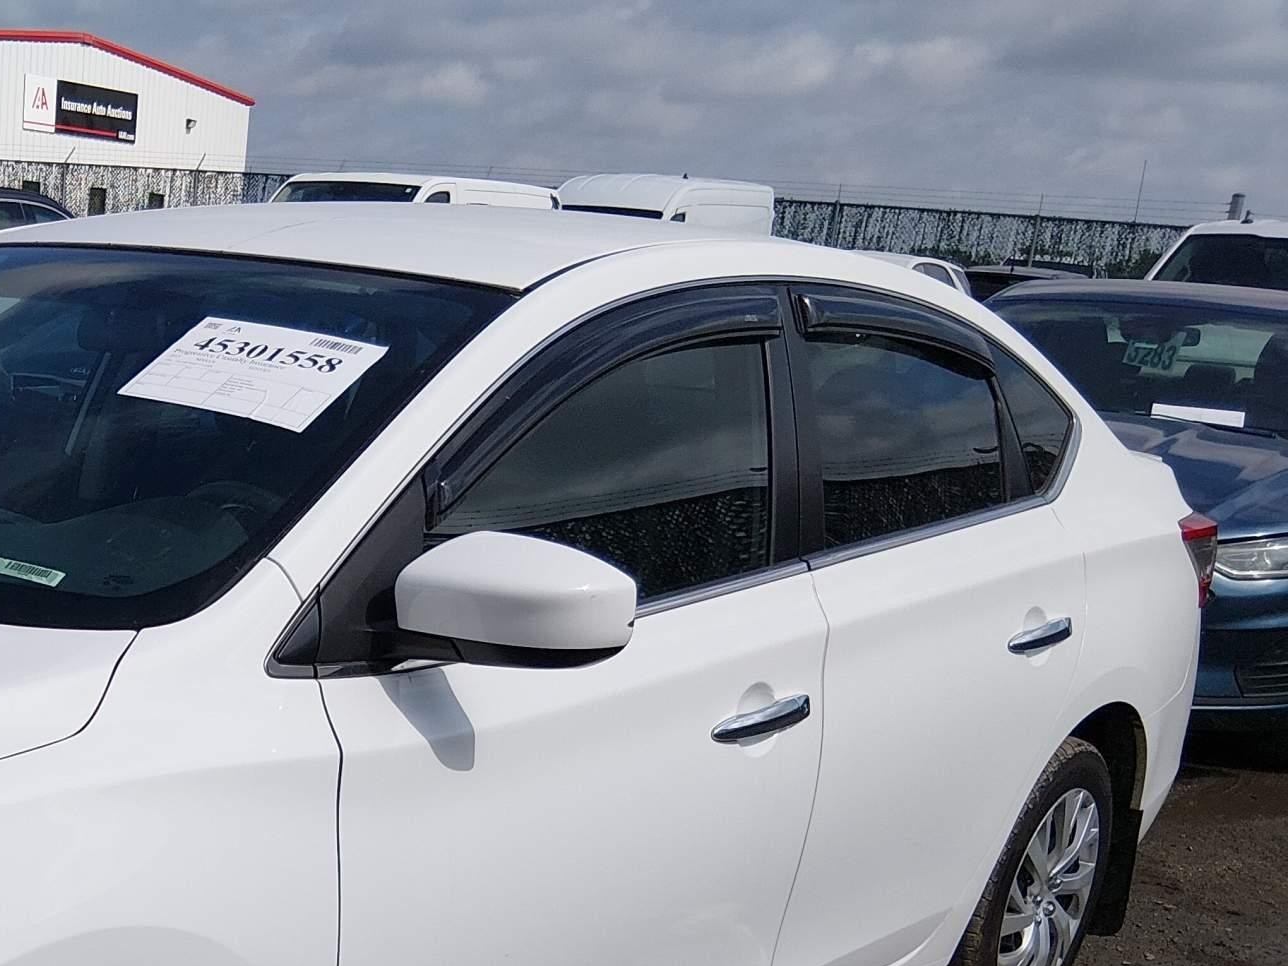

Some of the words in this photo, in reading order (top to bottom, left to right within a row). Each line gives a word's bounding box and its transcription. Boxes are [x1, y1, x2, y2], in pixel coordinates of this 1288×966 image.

[61, 97, 92, 114] Insurance
[92, 102, 107, 116] Auto
[106, 104, 133, 120] Auctions
[194, 336, 343, 373] 45301558
